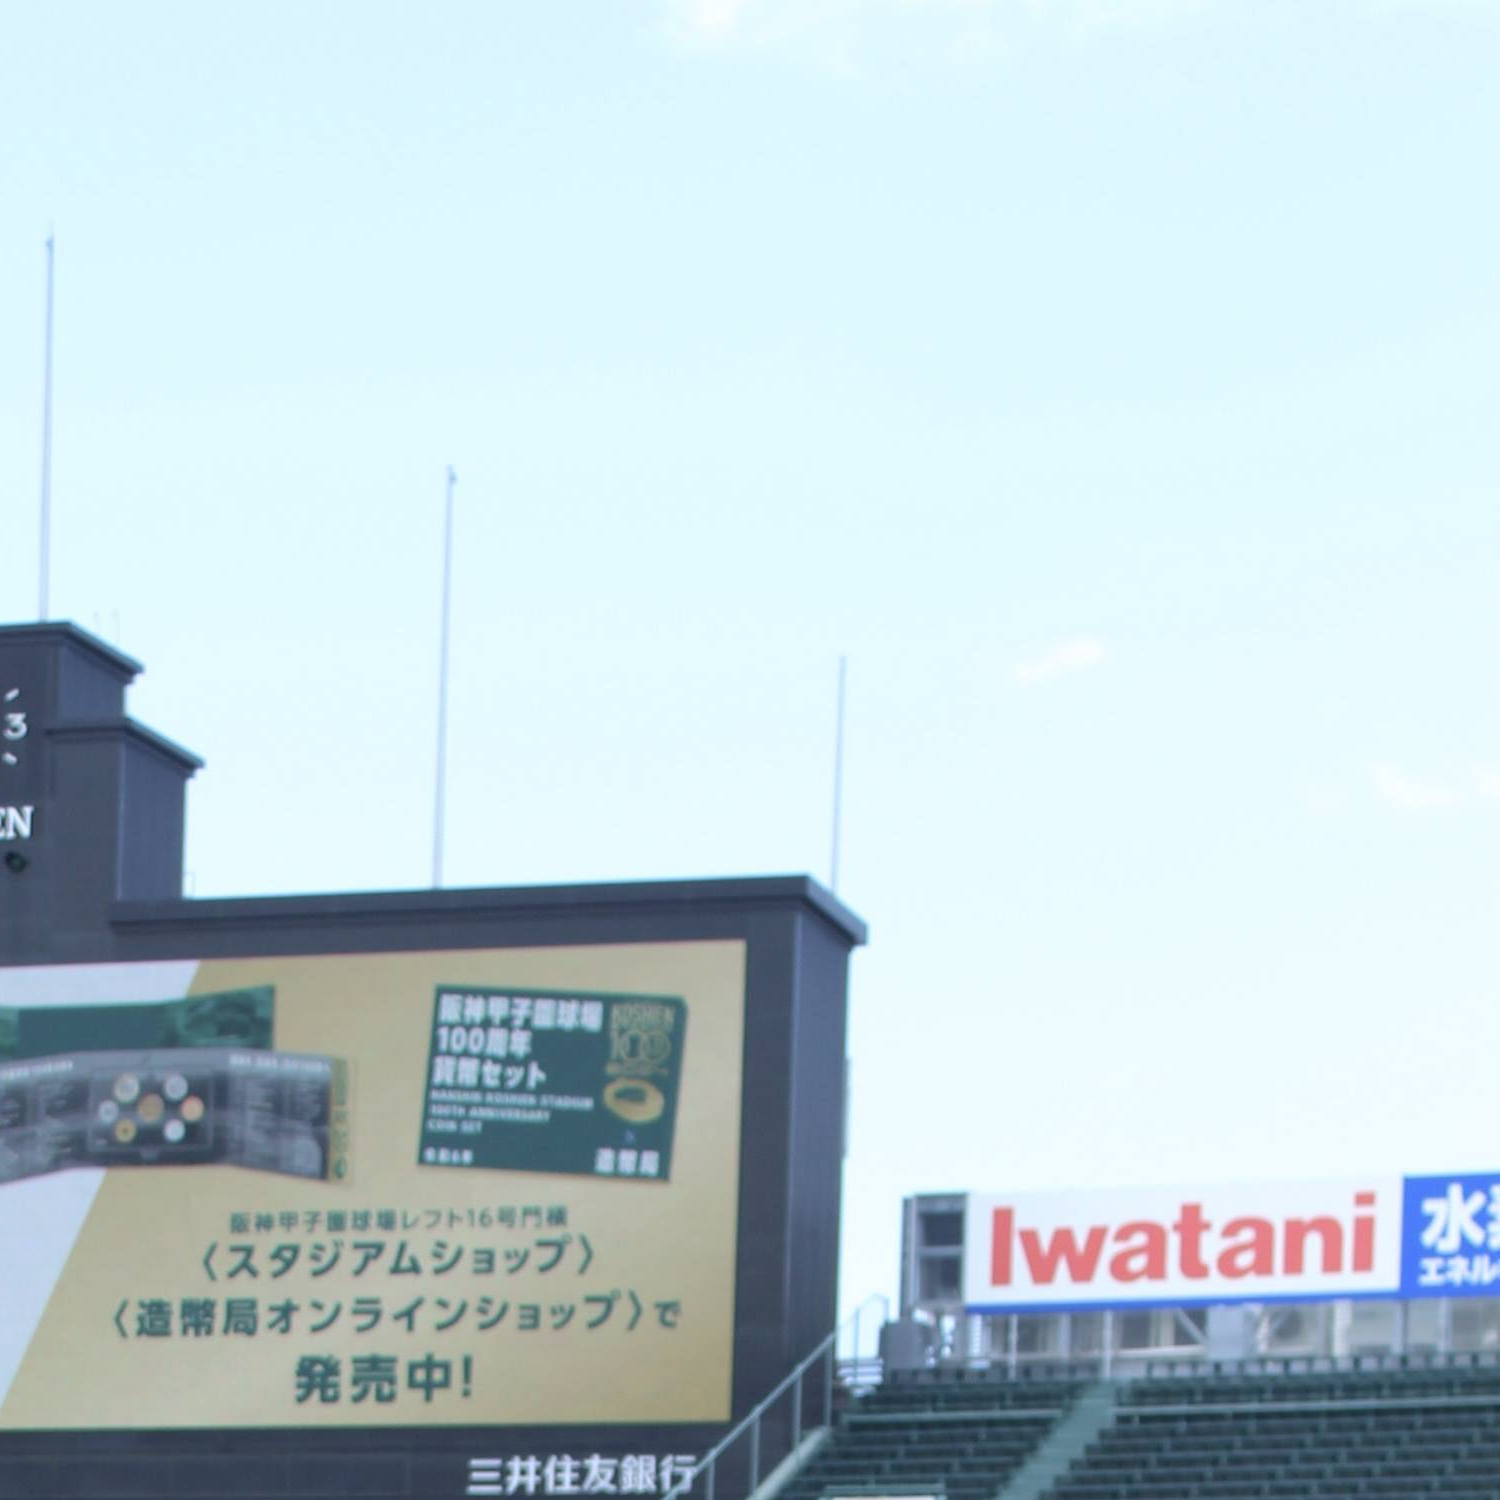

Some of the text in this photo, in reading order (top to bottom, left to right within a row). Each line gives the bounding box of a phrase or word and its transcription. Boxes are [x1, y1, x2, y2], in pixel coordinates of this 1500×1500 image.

[3, 713, 28, 739] 3
[991, 1191, 1376, 1287] Iwatani
[467, 1453, 697, 1496] 三井住友銀行
